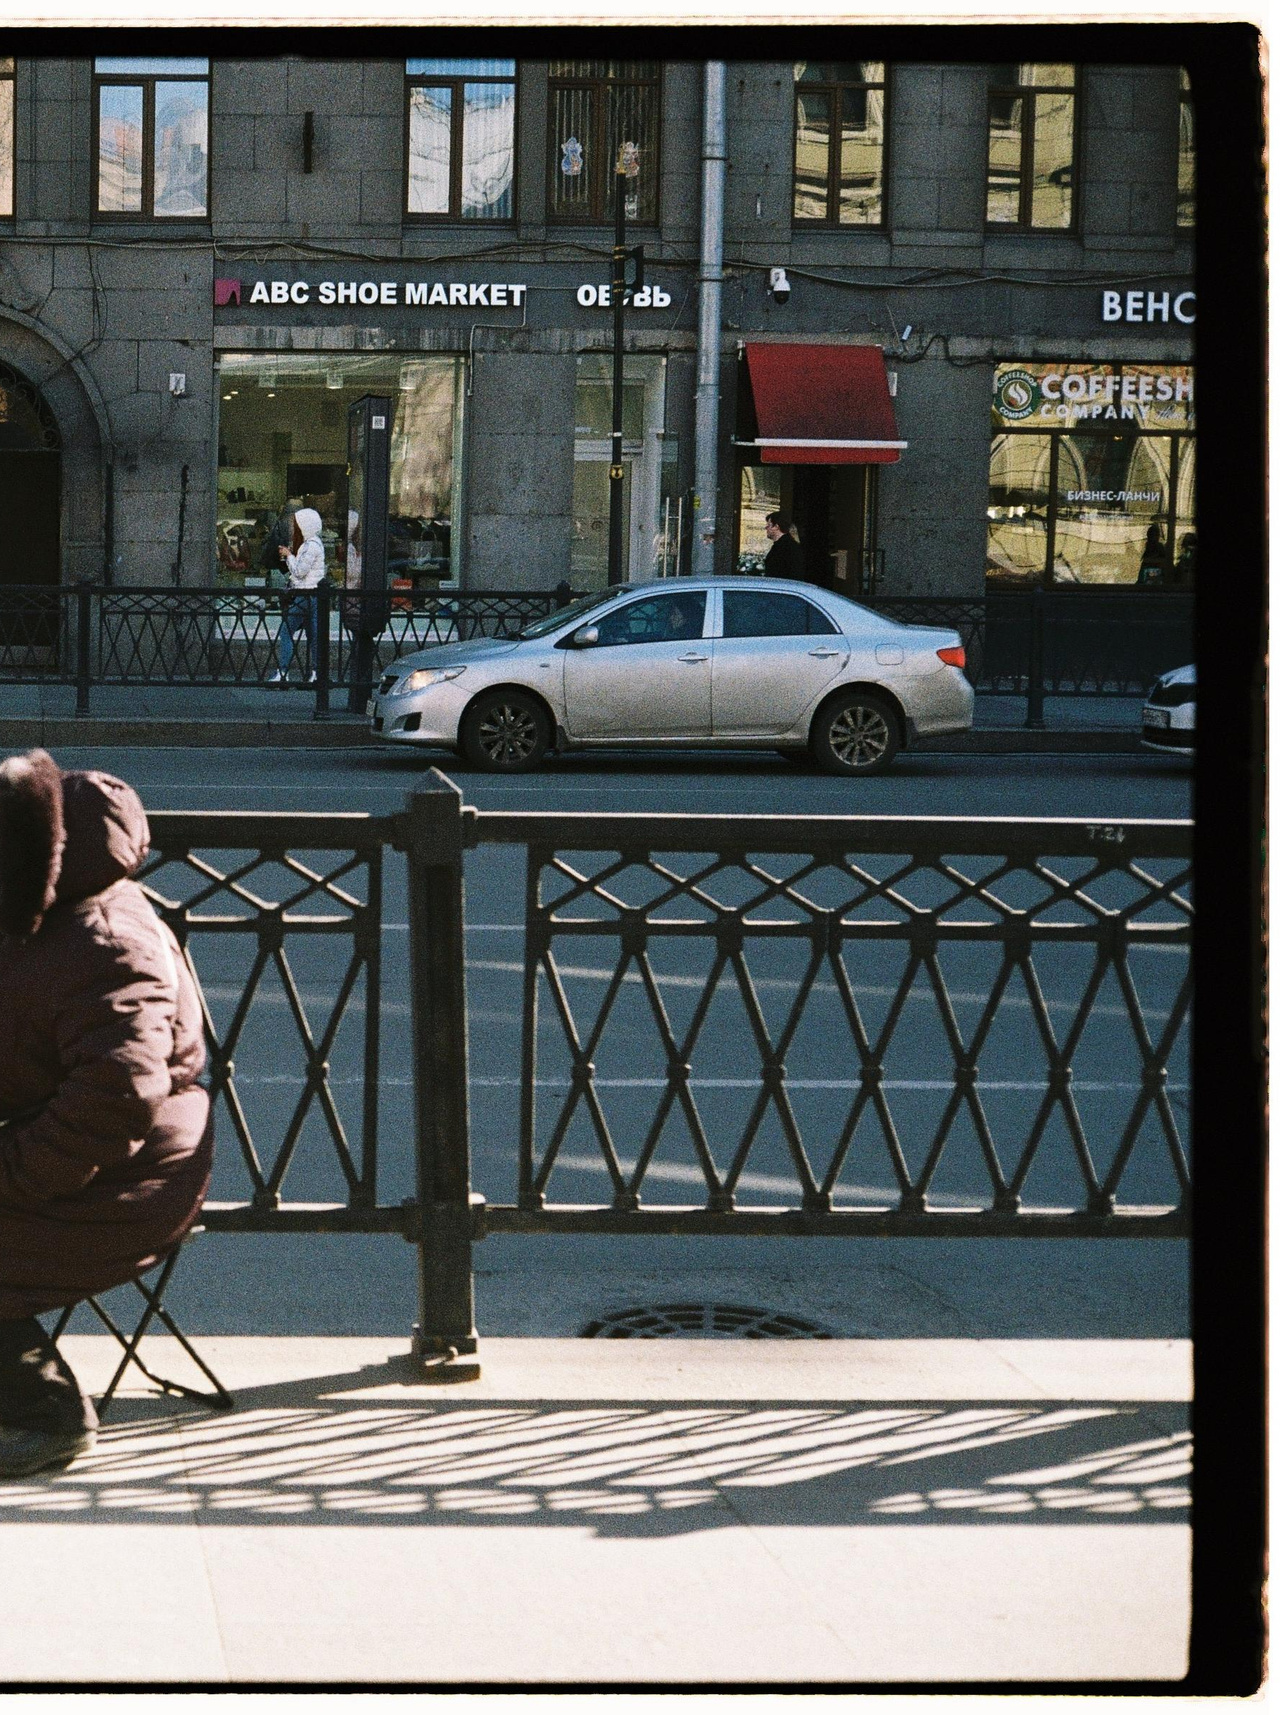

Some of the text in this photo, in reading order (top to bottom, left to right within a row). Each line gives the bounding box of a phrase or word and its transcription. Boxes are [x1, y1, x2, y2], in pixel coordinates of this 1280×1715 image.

[249, 281, 527, 306] ABC SHOE MARKET
[576, 284, 671, 307] ОБВЬ
[1103, 290, 1197, 324] ВЕНС
[1040, 404, 1151, 420] COMPANY
[1067, 490, 1160, 502] БИЗНЕС-ЛАНЧИ
